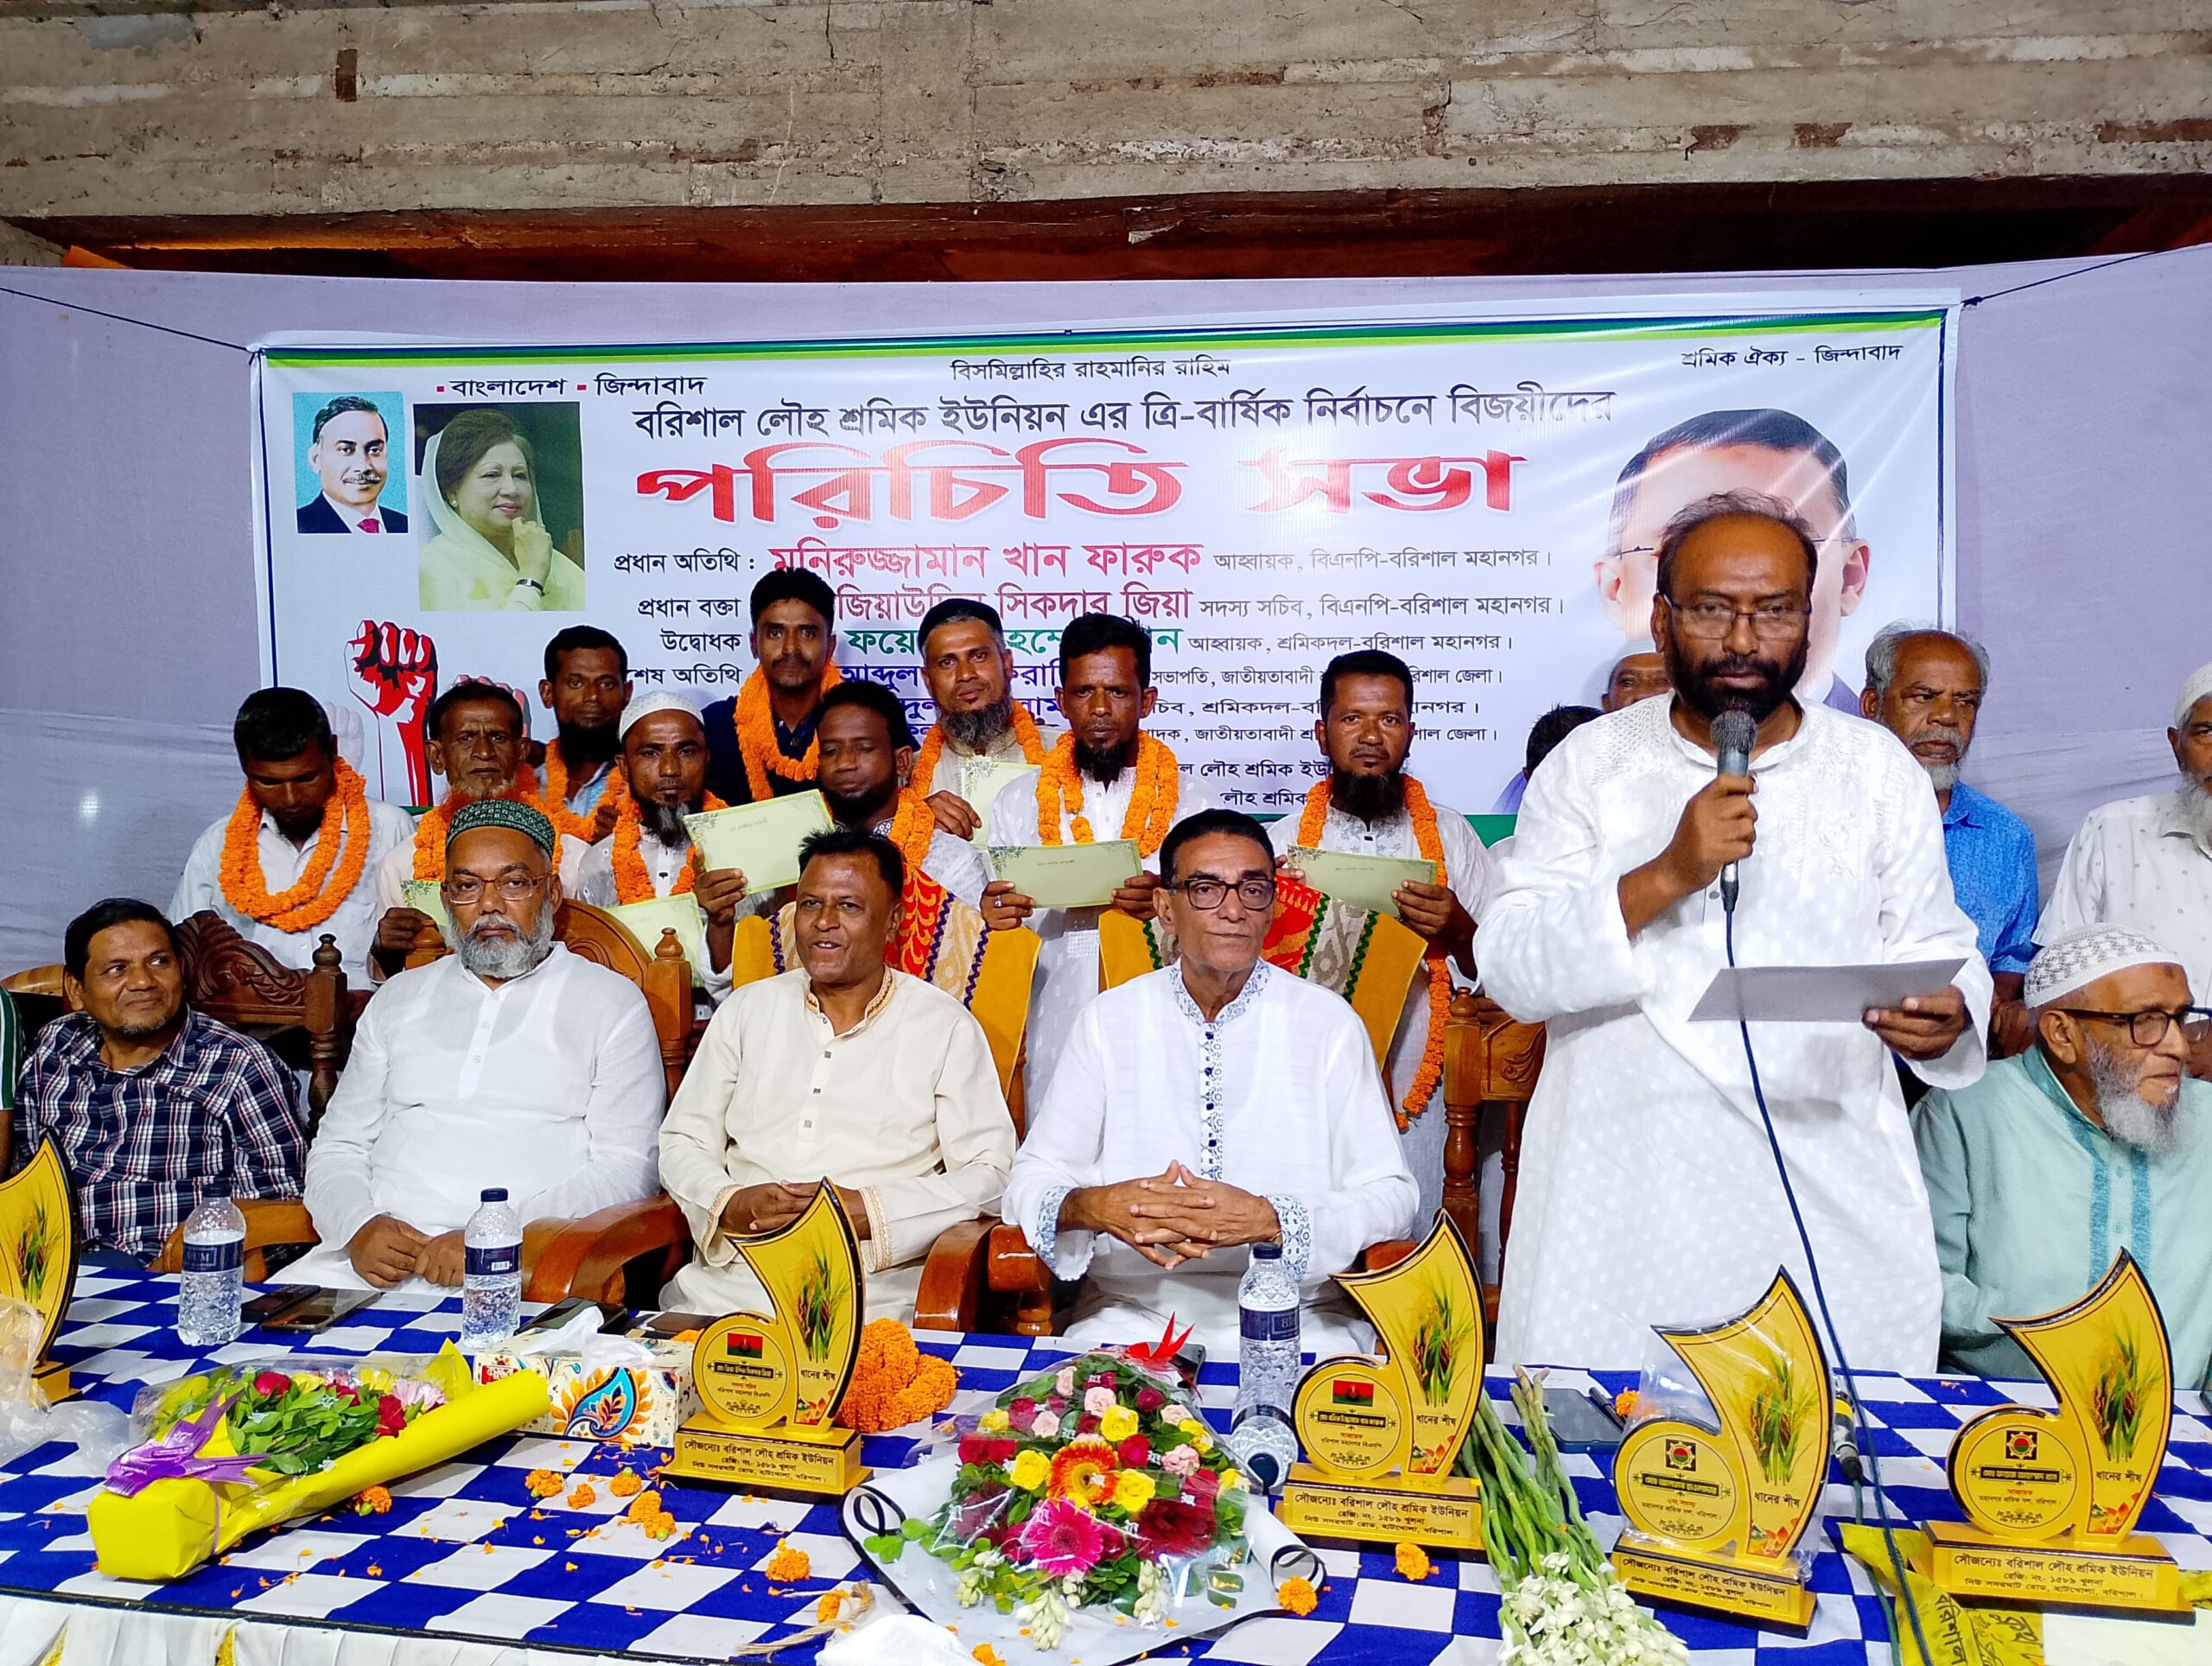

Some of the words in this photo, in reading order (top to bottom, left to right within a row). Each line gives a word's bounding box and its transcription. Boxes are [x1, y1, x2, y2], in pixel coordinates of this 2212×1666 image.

[950, 359, 1065, 380] বিসমিল্লাহির
[1072, 356, 1166, 378] রাহমানির
[1173, 354, 1230, 377] রাহিম
[1681, 347, 1738, 368] শ্রমিক
[1744, 346, 1789, 366] ঐক্য
[1814, 345, 1904, 364] জিন্দাবাদ
[448, 378, 569, 397] বাংলাদেশ
[593, 372, 708, 396] জিন্দাবাদ
[632, 400, 747, 439] বরিশাল
[757, 397, 830, 436] লৌহ
[839, 397, 928, 432] শ্রমিক
[938, 394, 1070, 435] ইউনিয়ন
[1081, 401, 1132, 431] এর
[1141, 388, 1294, 430] ত্রি-বার্ষিক
[1303, 385, 1438, 427] নির্বাচনে
[1447, 381, 1616, 424] বিজয়ীদের
[637, 437, 1189, 529] পরিচিতি
[1239, 445, 1528, 512] সভা
[614, 553, 668, 574] প্রধান
[673, 548, 741, 573] অতিথি
[767, 537, 989, 578] মনিরুজ্জামান
[1003, 542, 1071, 577] খান
[1081, 542, 1204, 575] ফারুক
[1310, 548, 1456, 570] বিএনপি-বরিশাল
[638, 598, 691, 618] প্রধান
[696, 597, 741, 618] বক্তা
[995, 582, 1116, 618] সিকদার
[1120, 581, 1194, 619] জিয়া
[1200, 598, 1250, 617] সদস্য
[1257, 595, 1313, 620] সচিব,
[1319, 594, 1469, 616] বিএনপি-বরিশাল
[660, 628, 742, 652] উদ্বোধক
[843, 630, 919, 655] ফয়ে
[627, 667, 666, 684] শেষ
[672, 664, 743, 684] অতিথি
[1152, 666, 1216, 687] সভাপতি,
[1221, 666, 1315, 685] জাতীয়তাবাদী
[1408, 665, 1450, 684] রিশাল
[1152, 698, 1195, 716] চিব,
[1194, 724, 1295, 741] জাতীয়তাবাদী
[1200, 760, 1240, 777] লৌহ
[1244, 760, 1294, 777] শ্রমিক
[1416, 1415, 1438, 1425] ধানের
[1441, 1414, 1457, 1426] শীষ
[724, 1444, 752, 1456] বরিশাল
[755, 1447, 773, 1459] লৌহ
[776, 1450, 799, 1461] শ্রমিক
[801, 1453, 835, 1466] ইউনিয়ন
[2096, 1471, 2121, 1481] ধানের
[2125, 1470, 2142, 1483] শীষ
[1340, 1496, 1373, 1510] বরিশাল
[1376, 1499, 1399, 1512] লৌহ
[1402, 1502, 1427, 1514] শ্রমিক
[1430, 1504, 1469, 1517] ইউনিয়ন
[1754, 1491, 1779, 1504] ধানের
[1783, 1493, 1801, 1508] শীষ
[2005, 1556, 2044, 1570] বরিশাল
[2048, 1560, 2074, 1573] লৌহ
[2076, 1562, 2107, 1574] শ্রমিক
[2110, 1565, 2154, 1579] ইউনিয়ন
